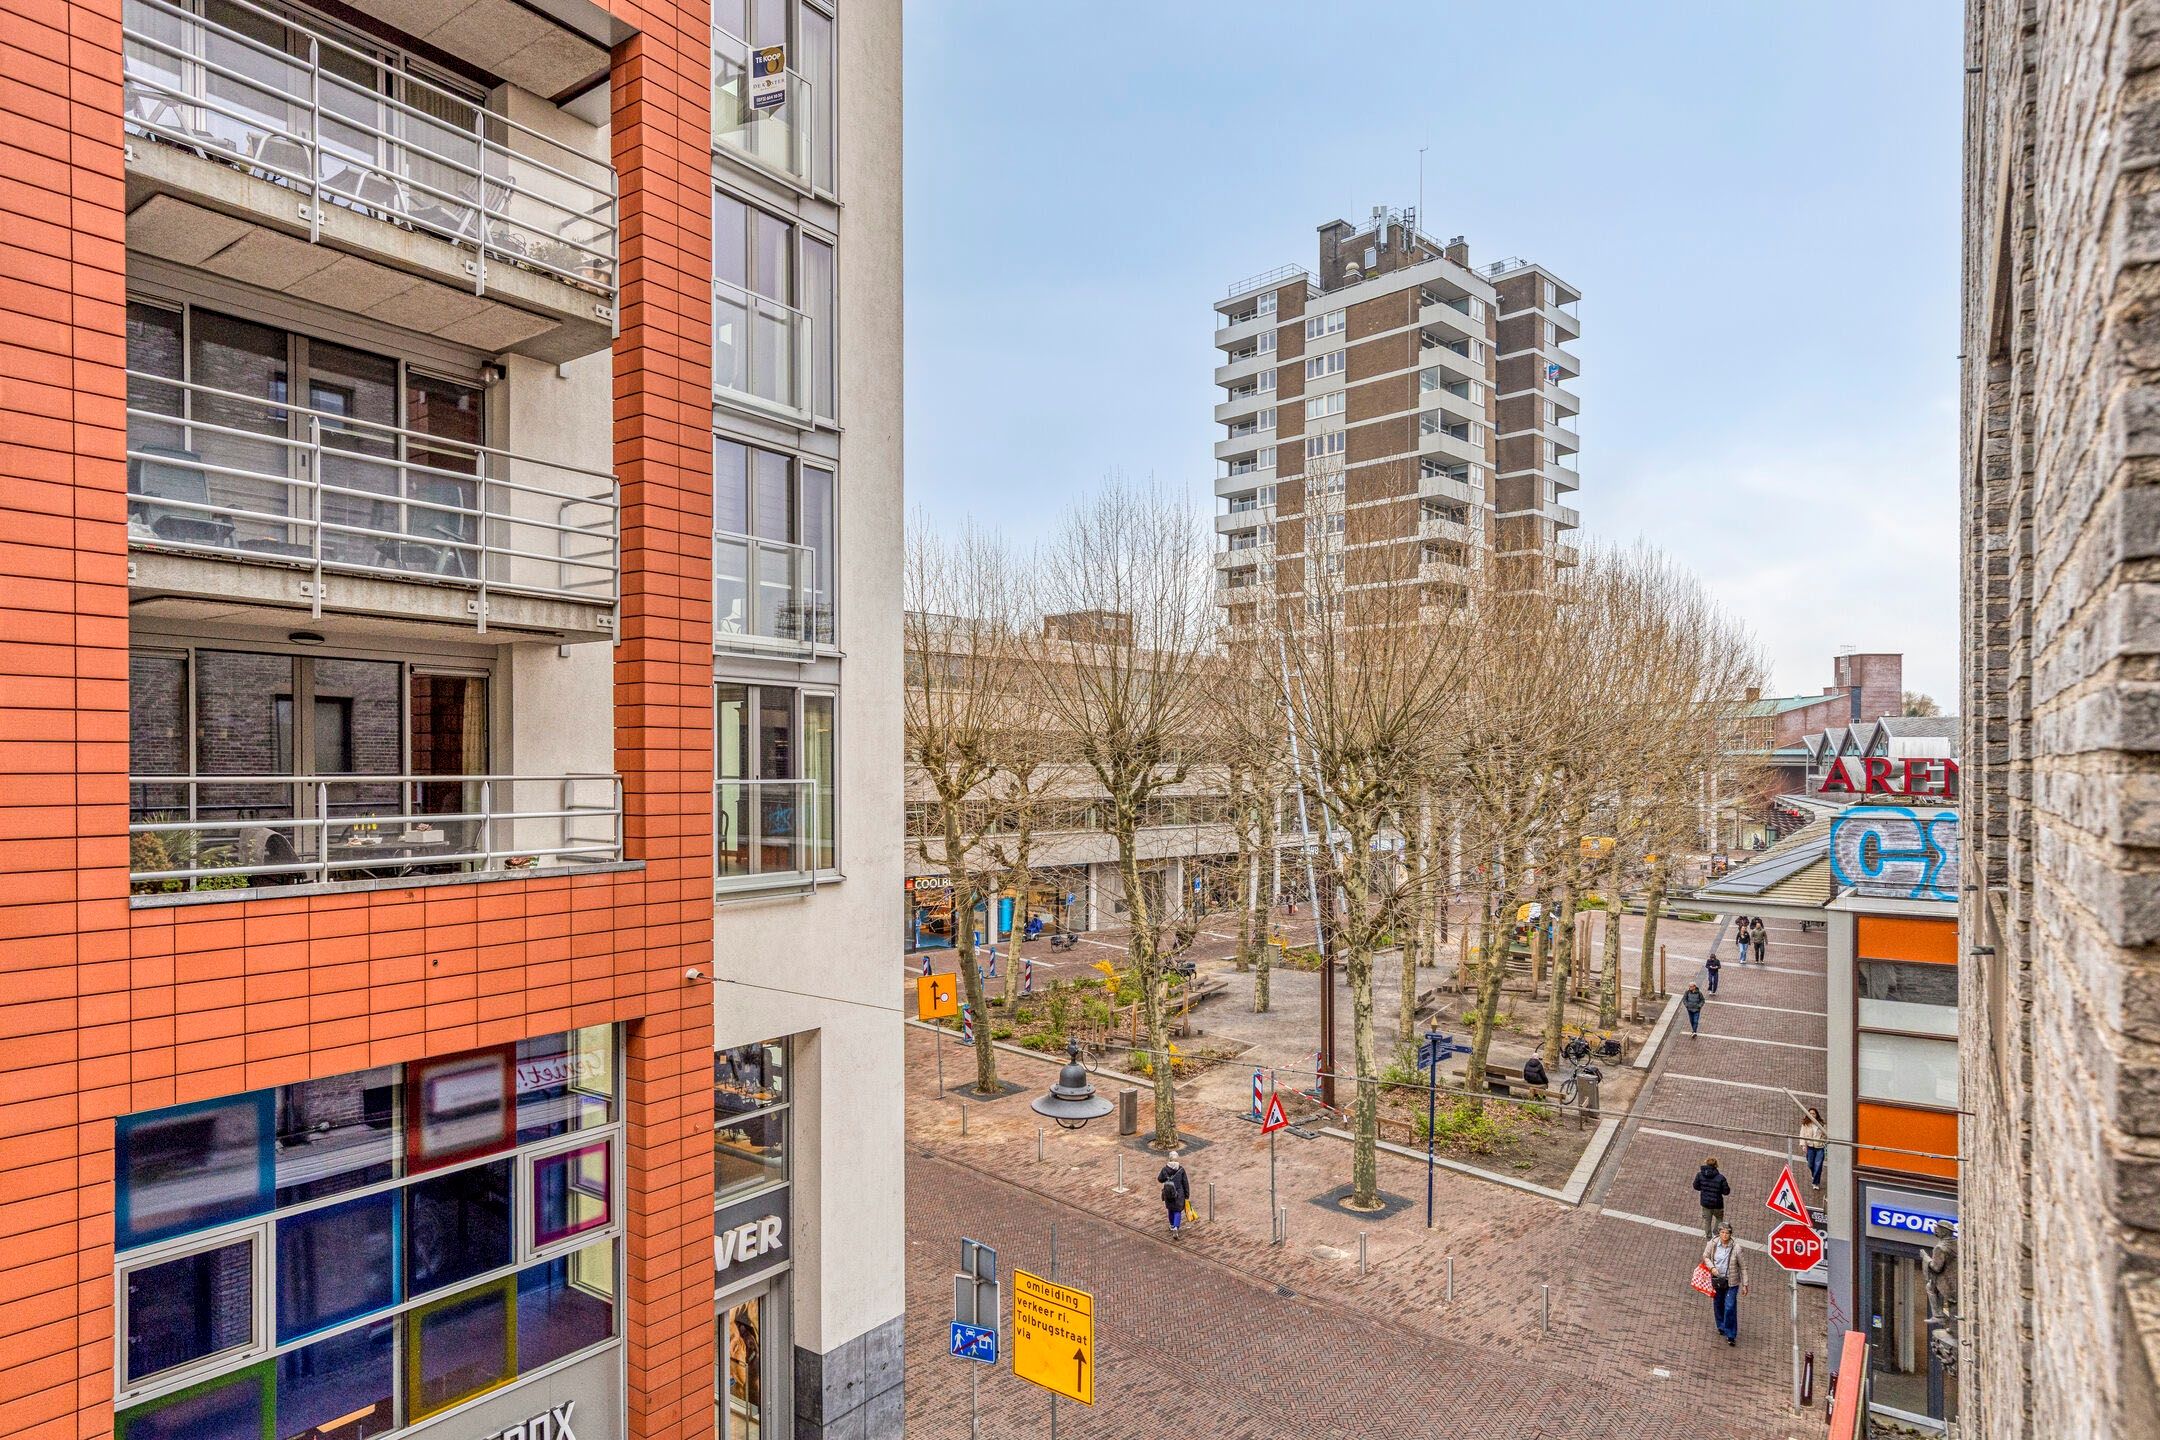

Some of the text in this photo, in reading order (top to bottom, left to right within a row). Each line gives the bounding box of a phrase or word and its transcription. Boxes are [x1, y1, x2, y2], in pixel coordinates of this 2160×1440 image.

[755, 52, 781, 64] TE KOOP
[1877, 1209, 1960, 1240] SPOR
[714, 1214, 783, 1272] VER
[1772, 1237, 1820, 1257] STOP
[1026, 1281, 1079, 1309] omleiding
[1017, 1297, 1055, 1318] verkeer
[1017, 1309, 1088, 1346] Tolbrugstraat
[1017, 1327, 1032, 1340] via
